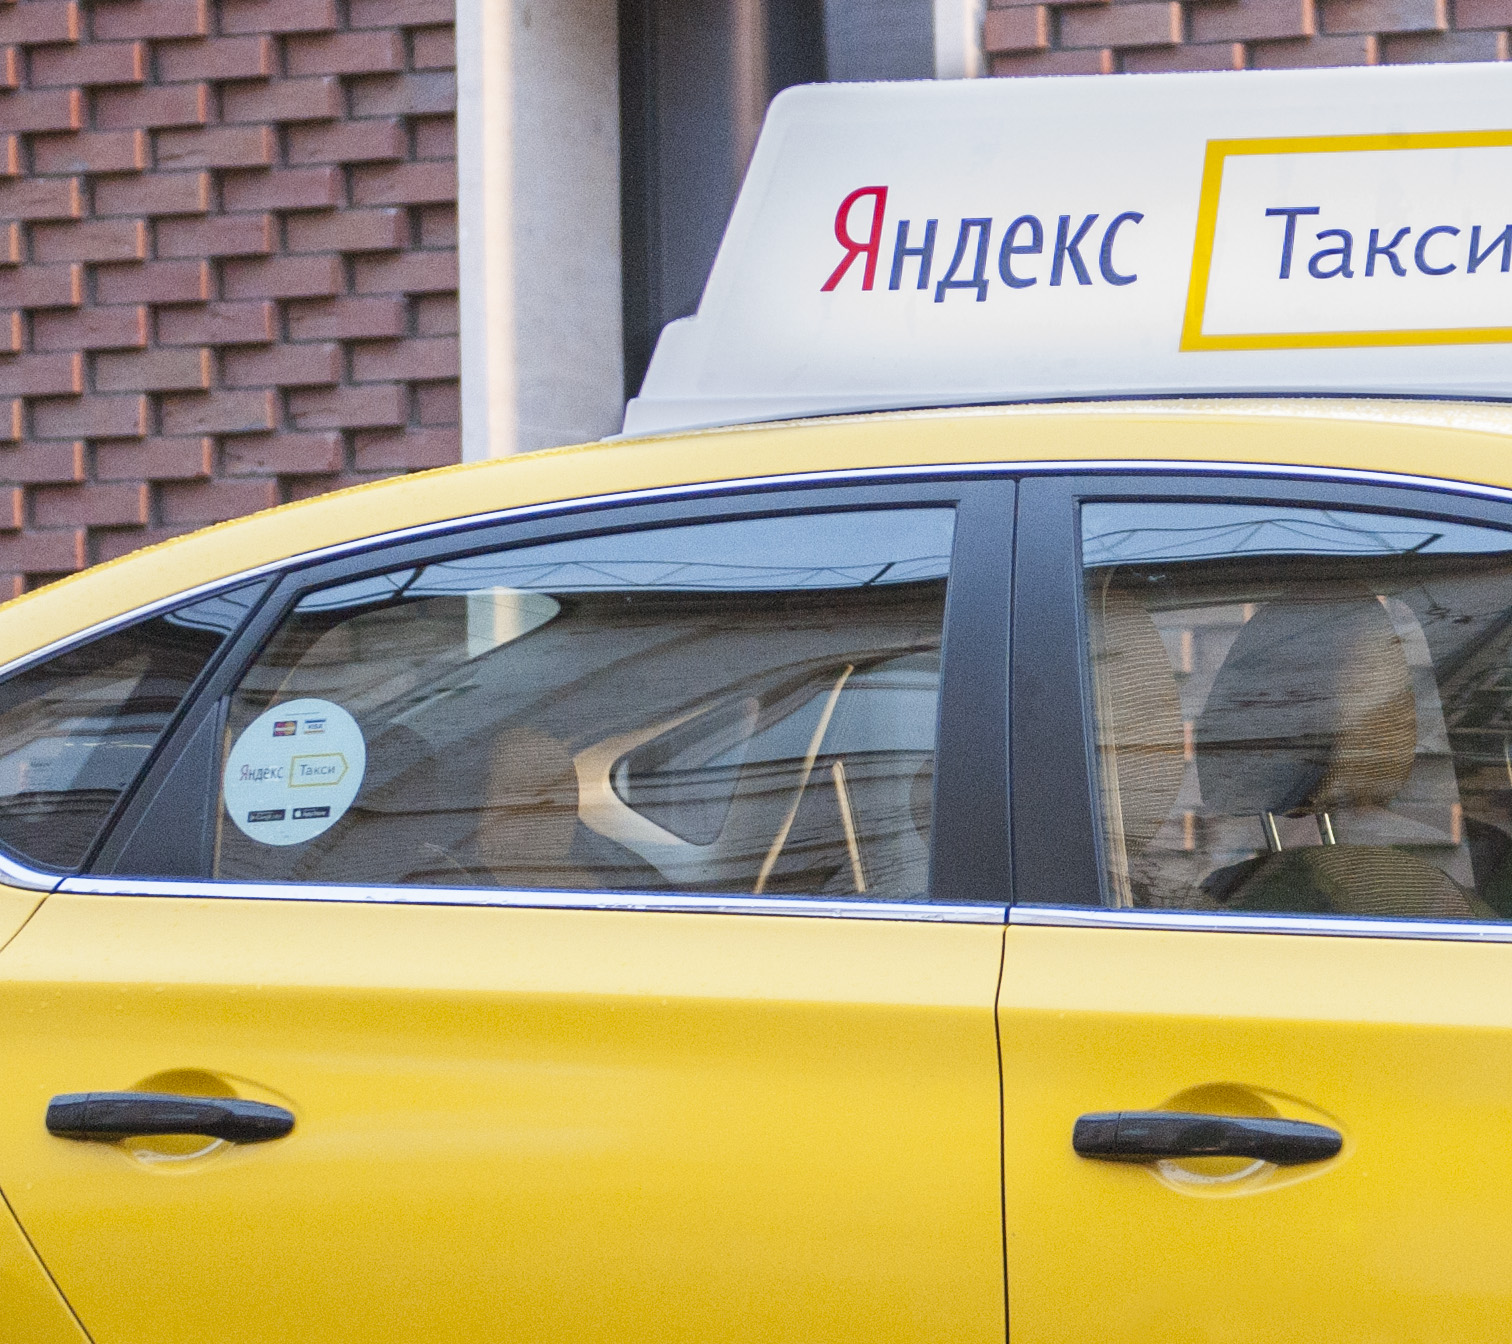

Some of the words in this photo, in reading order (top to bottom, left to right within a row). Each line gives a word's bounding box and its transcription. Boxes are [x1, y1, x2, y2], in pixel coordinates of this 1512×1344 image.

[820, 184, 1145, 304] Яндекс
[239, 763, 285, 782] Яндекс
[300, 763, 336, 777] Такси
